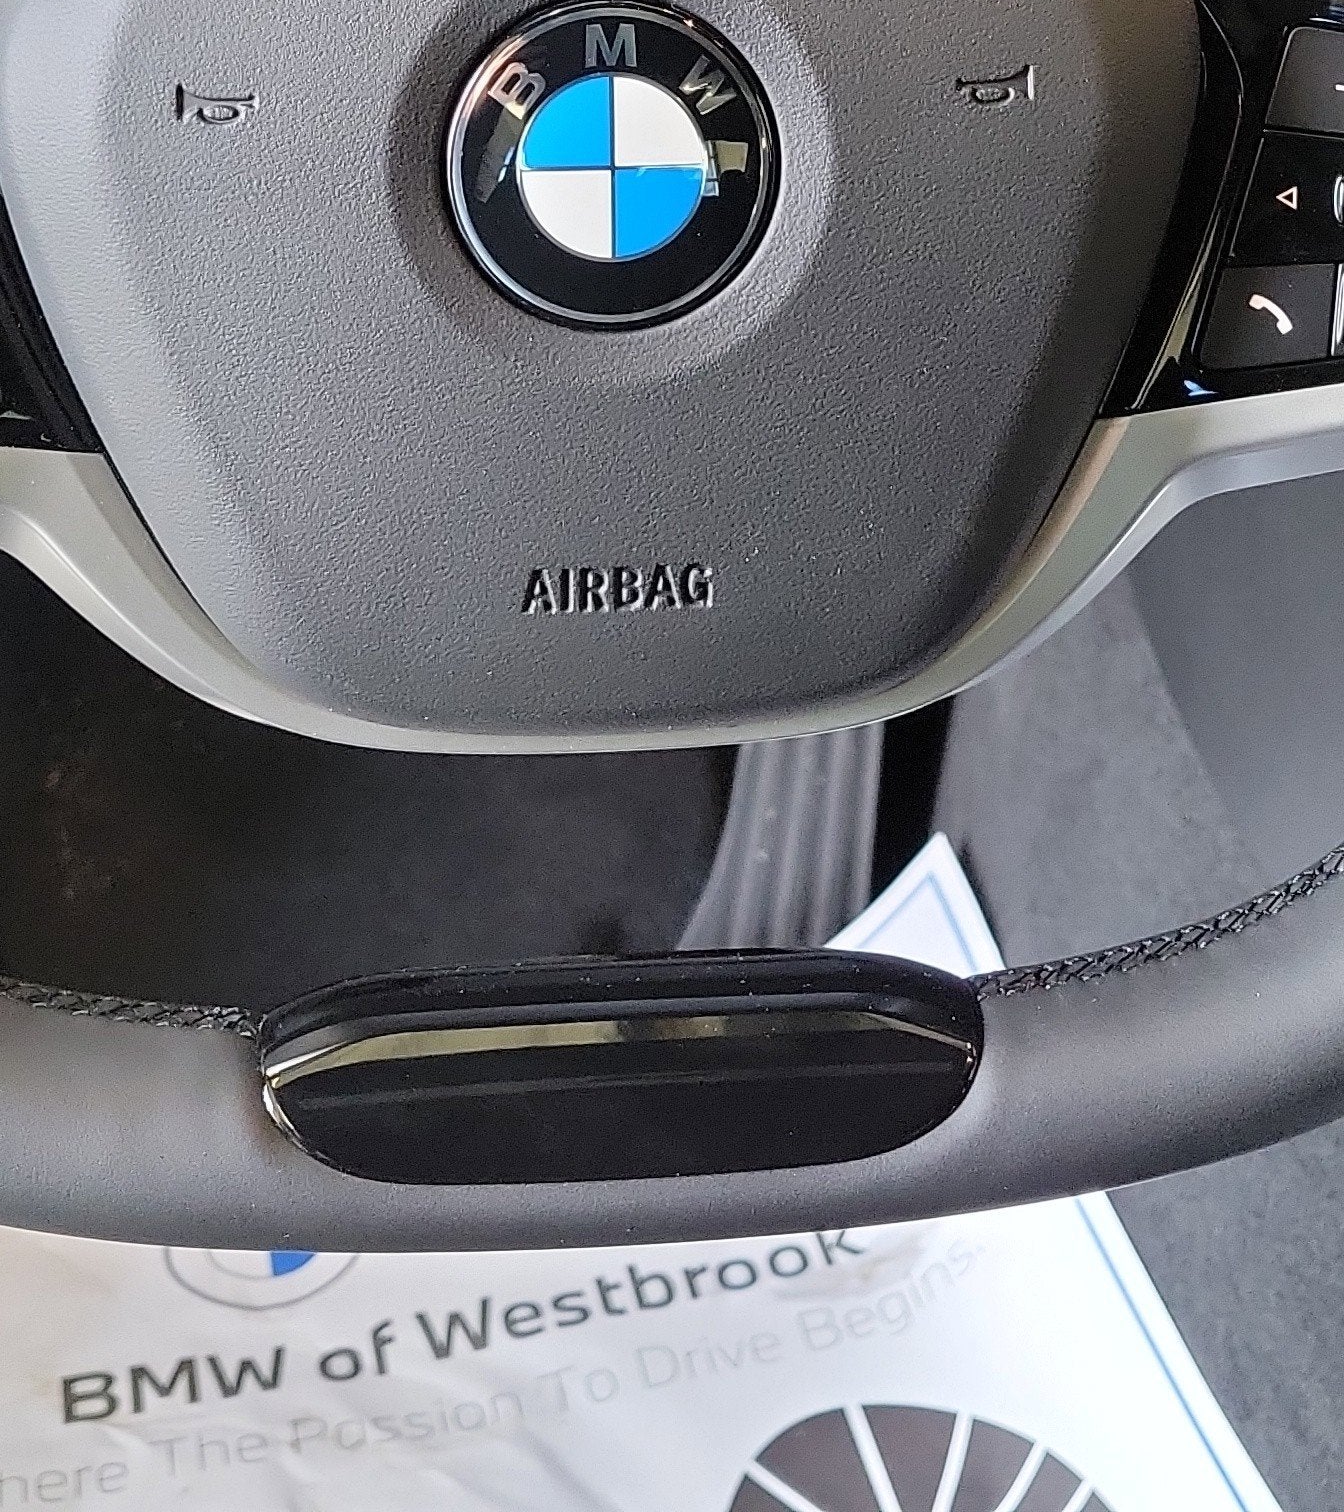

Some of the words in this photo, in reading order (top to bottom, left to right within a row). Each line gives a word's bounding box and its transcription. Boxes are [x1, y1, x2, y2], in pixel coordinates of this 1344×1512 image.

[487, 22, 738, 121] BMW
[520, 562, 714, 616] AIRBAG
[60, 1344, 284, 1425] BMW
[318, 1320, 396, 1383] of
[415, 1230, 864, 1362] Westbrook
[149, 1427, 270, 1477] The
[288, 1389, 524, 1455] Passion
[536, 1364, 618, 1415] To
[634, 1324, 786, 1391] Drive
